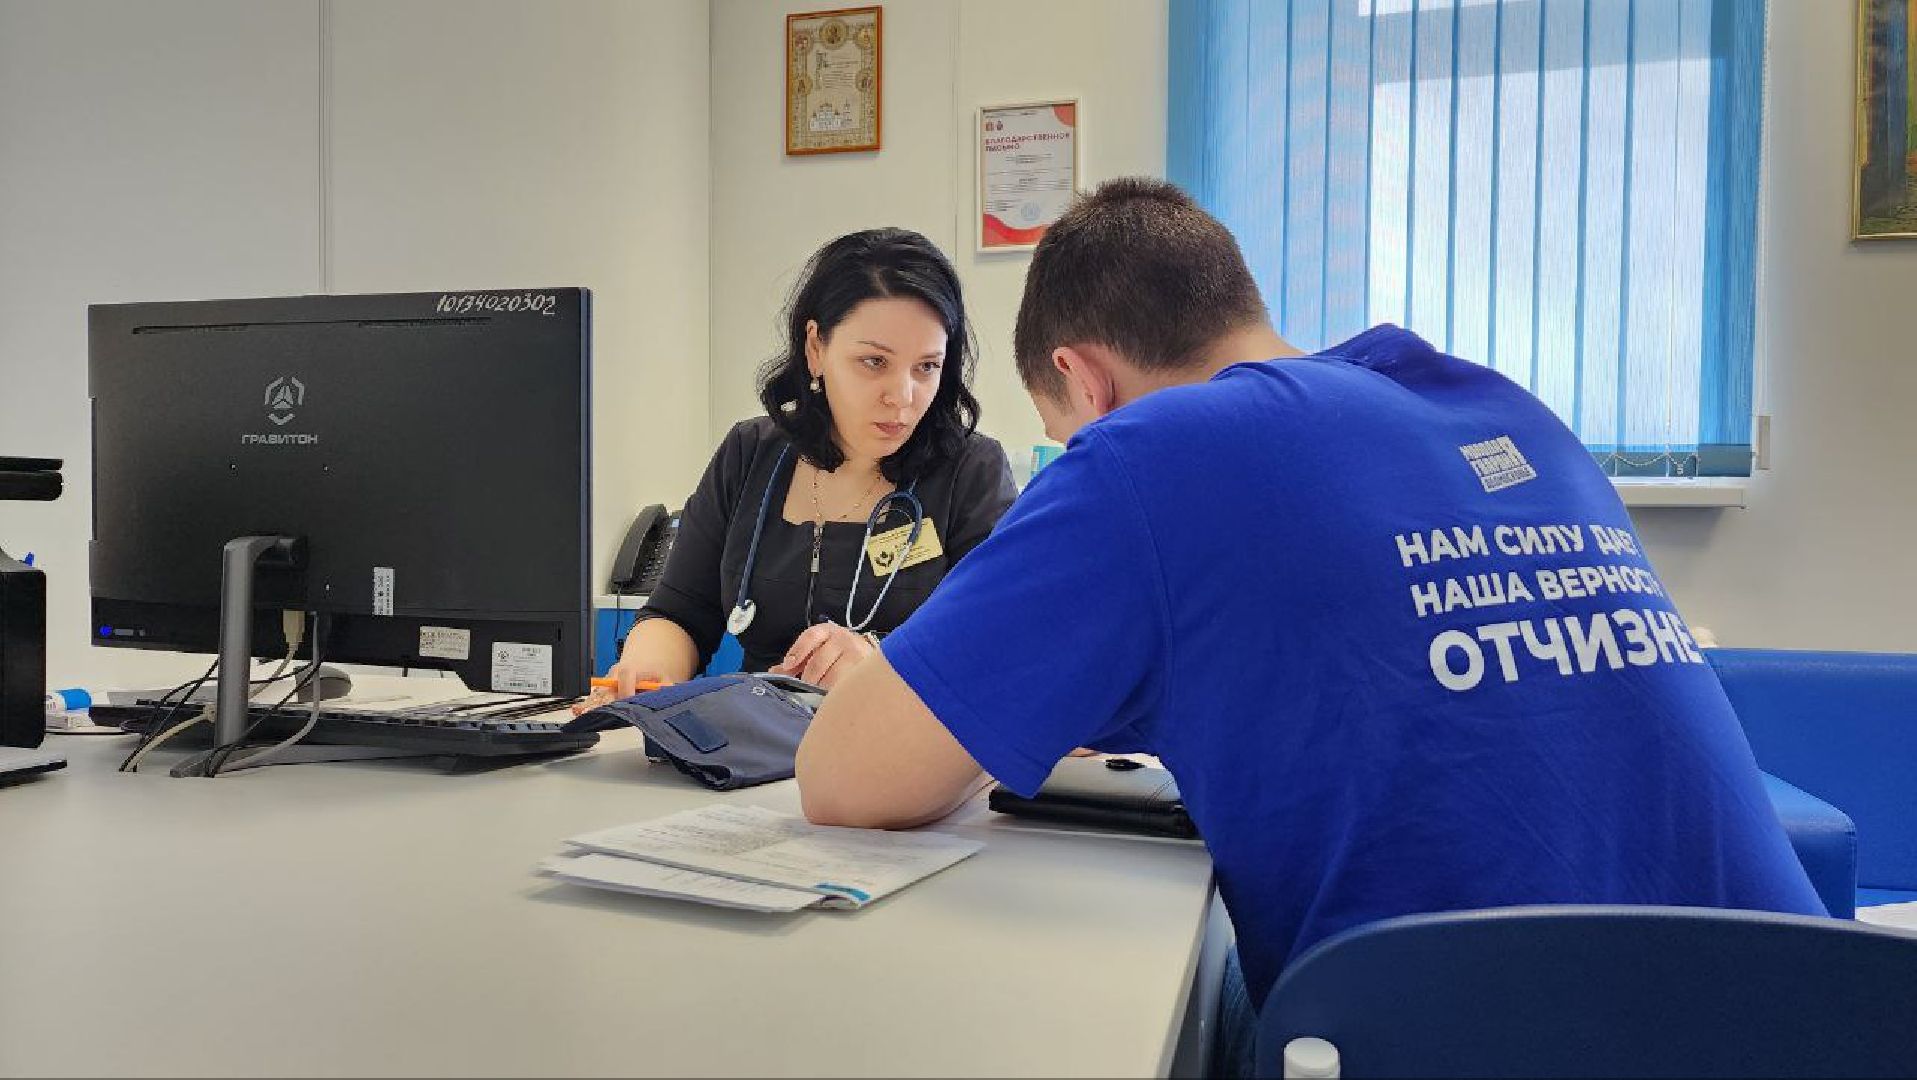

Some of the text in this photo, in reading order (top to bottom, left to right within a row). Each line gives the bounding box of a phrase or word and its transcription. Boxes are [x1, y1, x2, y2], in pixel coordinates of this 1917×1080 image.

[241, 434, 318, 445] ГРАВИТОН
[1395, 524, 1490, 568] НАМ
[1494, 524, 1585, 556] СИЛУ
[1410, 571, 1536, 618] НАША
[1429, 608, 1705, 692] ОТЧИЗНЕ
